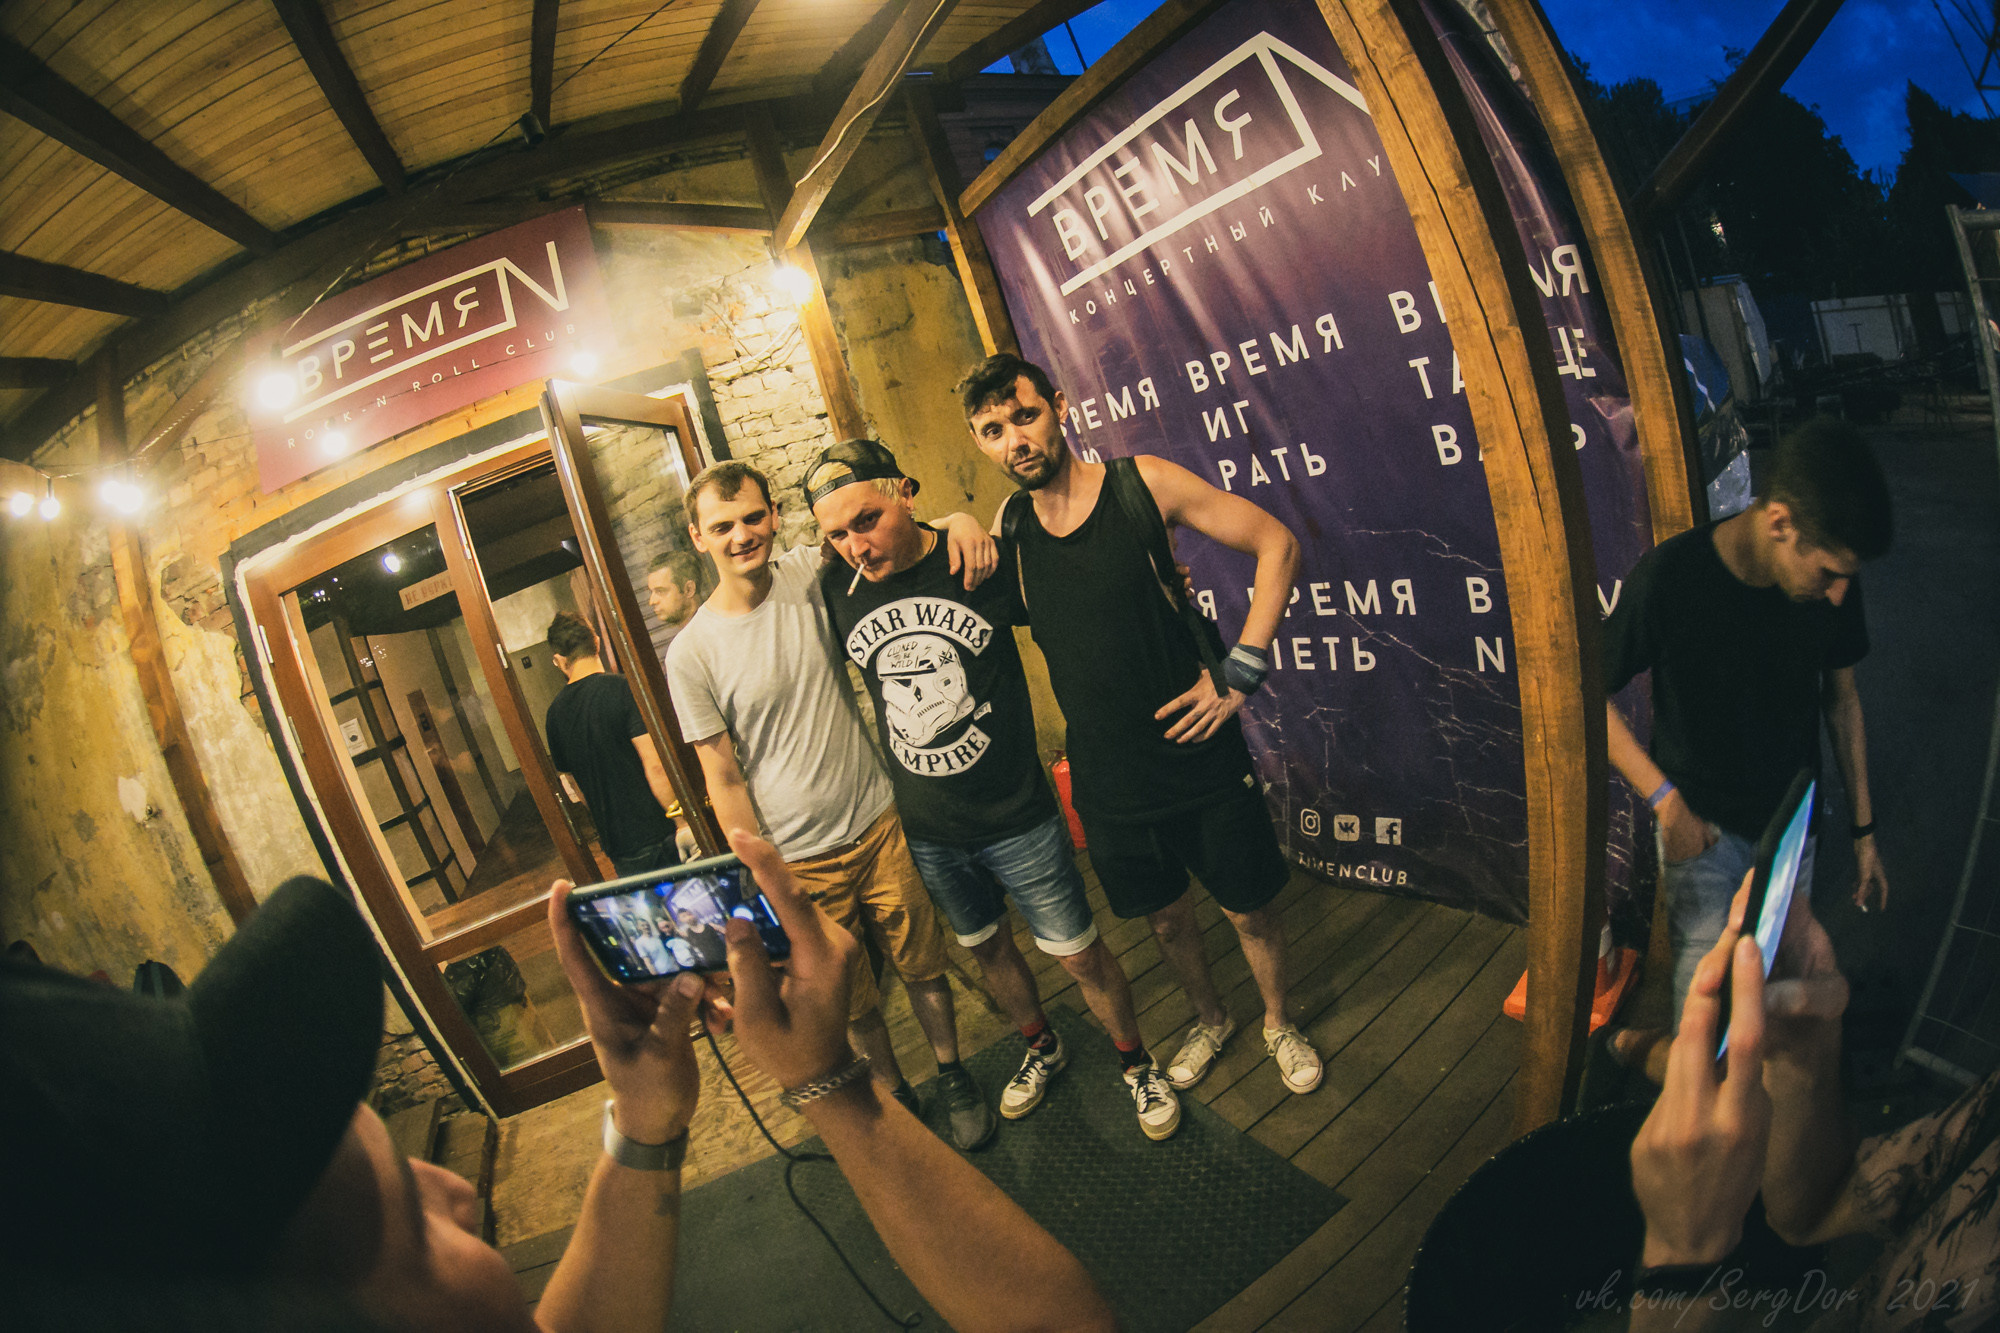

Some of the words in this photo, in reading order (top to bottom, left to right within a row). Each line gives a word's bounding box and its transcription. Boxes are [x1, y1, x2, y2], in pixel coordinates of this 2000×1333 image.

[1053, 89, 1252, 262] ВРЕМЯ
[1069, 206, 1275, 325] КОНЦЕРТНЫЙ
[297, 286, 480, 396] ВРЕМЯ
[412, 358, 480, 392] ROLL
[505, 323, 576, 355] CLUB
[1185, 313, 1344, 394] ВРЕМЯ
[1201, 399, 1250, 442] ИГ
[1217, 442, 1327, 491] РАТЬ
[850, 607, 907, 661] STAR
[914, 602, 989, 649] WARS
